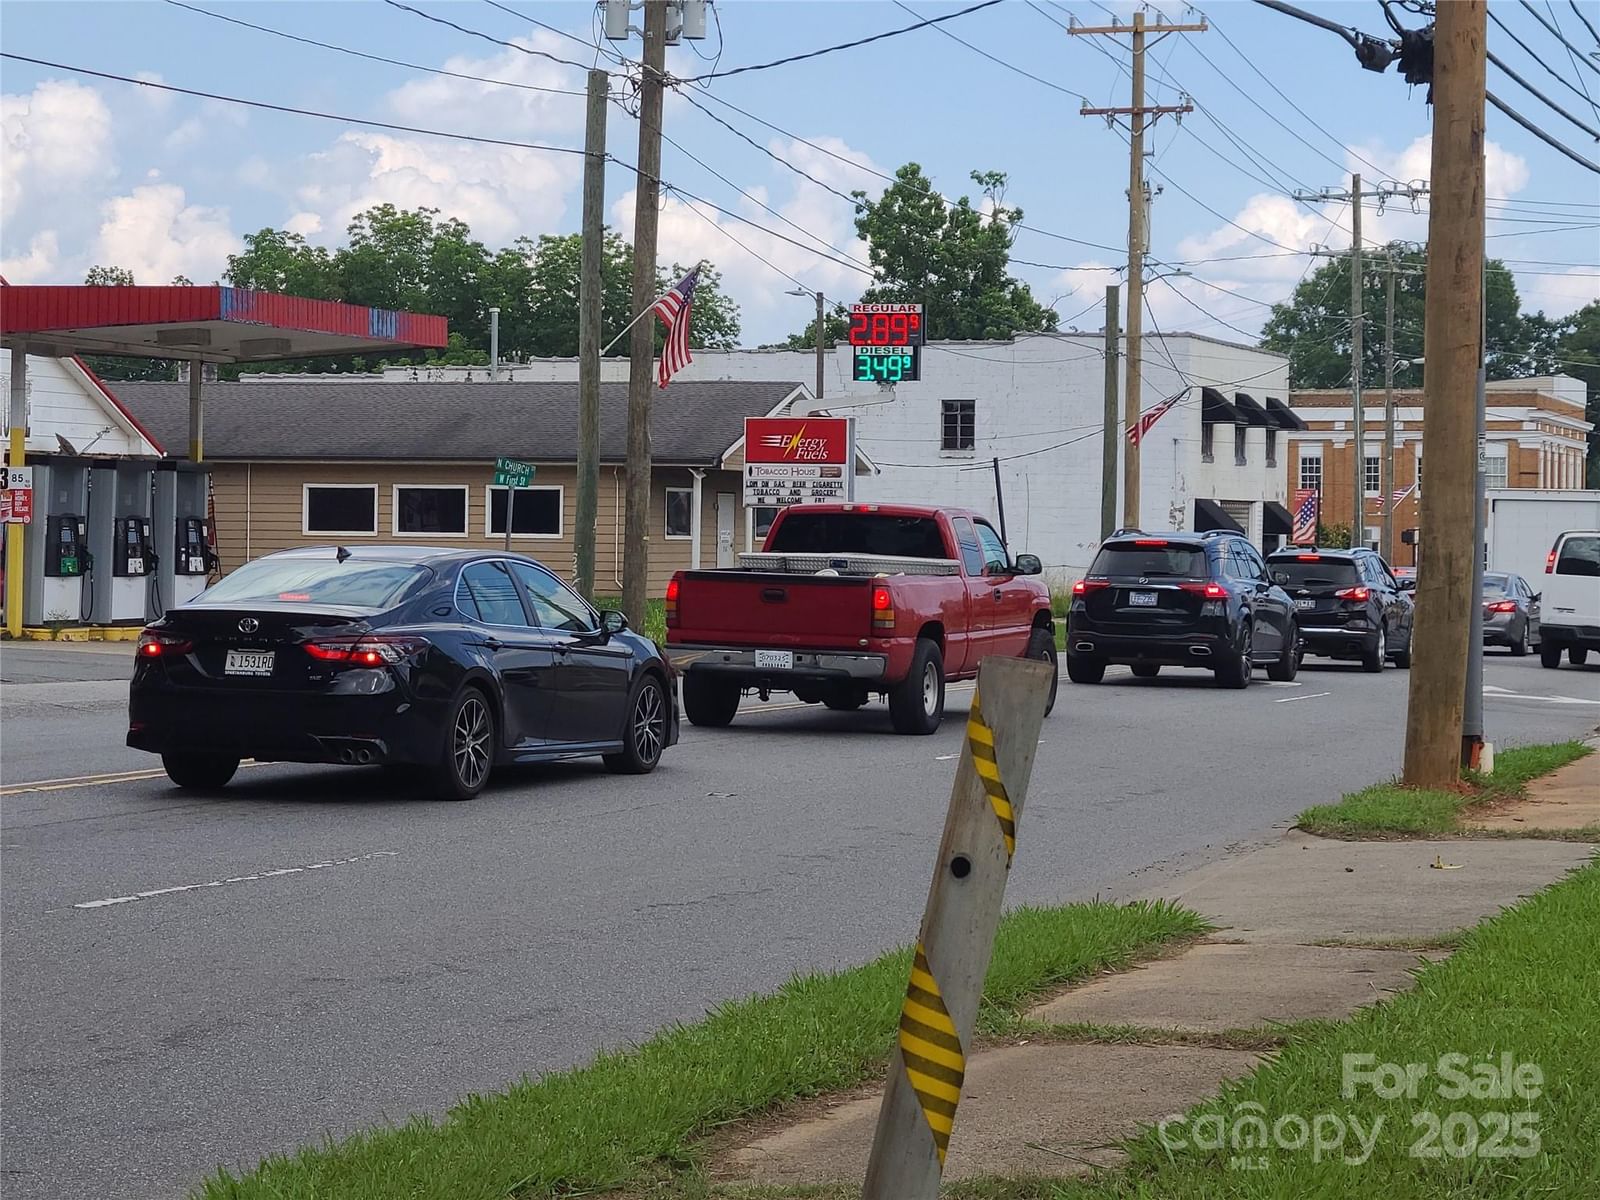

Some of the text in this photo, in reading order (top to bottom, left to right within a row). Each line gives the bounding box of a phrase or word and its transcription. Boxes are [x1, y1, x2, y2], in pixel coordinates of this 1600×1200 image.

[853, 304, 917, 313] REGULAR
[860, 347, 908, 355] DIESEL
[794, 446, 829, 460] Fuels
[497, 458, 530, 475] N CHURCH
[11, 473, 23, 482] 85
[761, 481, 769, 489] ON
[773, 481, 785, 489] GAS
[792, 481, 806, 489] BEER
[812, 481, 843, 489] CIGARETTE
[753, 488, 837, 497] TOBACCO AND GROCERY
[757, 496, 766, 504] WE
[776, 496, 803, 505] WELCOME
[239, 655, 274, 669] 1531RD
